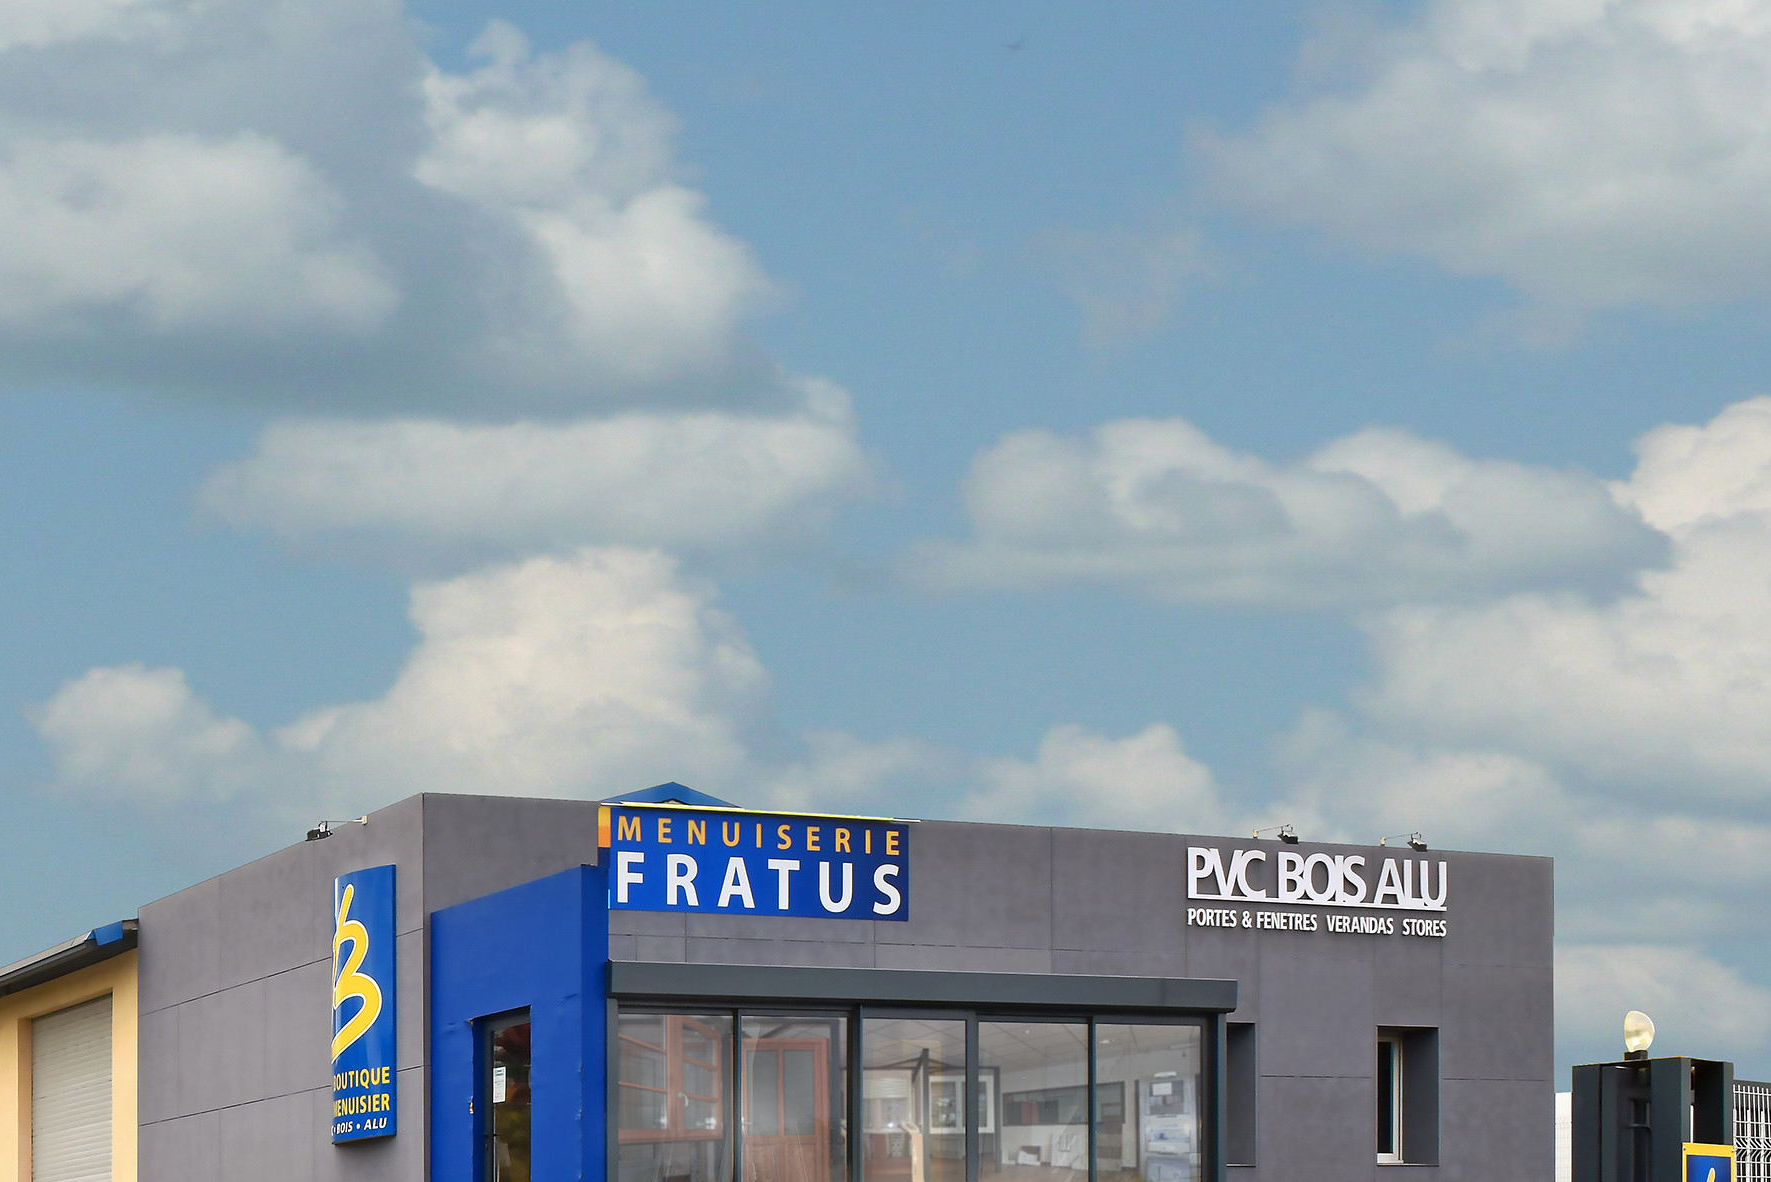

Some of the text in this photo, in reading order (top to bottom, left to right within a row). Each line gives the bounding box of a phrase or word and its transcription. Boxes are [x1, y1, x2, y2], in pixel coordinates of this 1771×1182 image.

[617, 815, 900, 856] MENUISERIE
[617, 851, 901, 915] FRATUS
[1188, 846, 1447, 908] PVC BOIS ALU
[1187, 907, 1447, 937] PORTES & FENETRES VERANDAS STORES
[336, 1121, 353, 1134] BOIS
[364, 1117, 387, 1131] ALU
